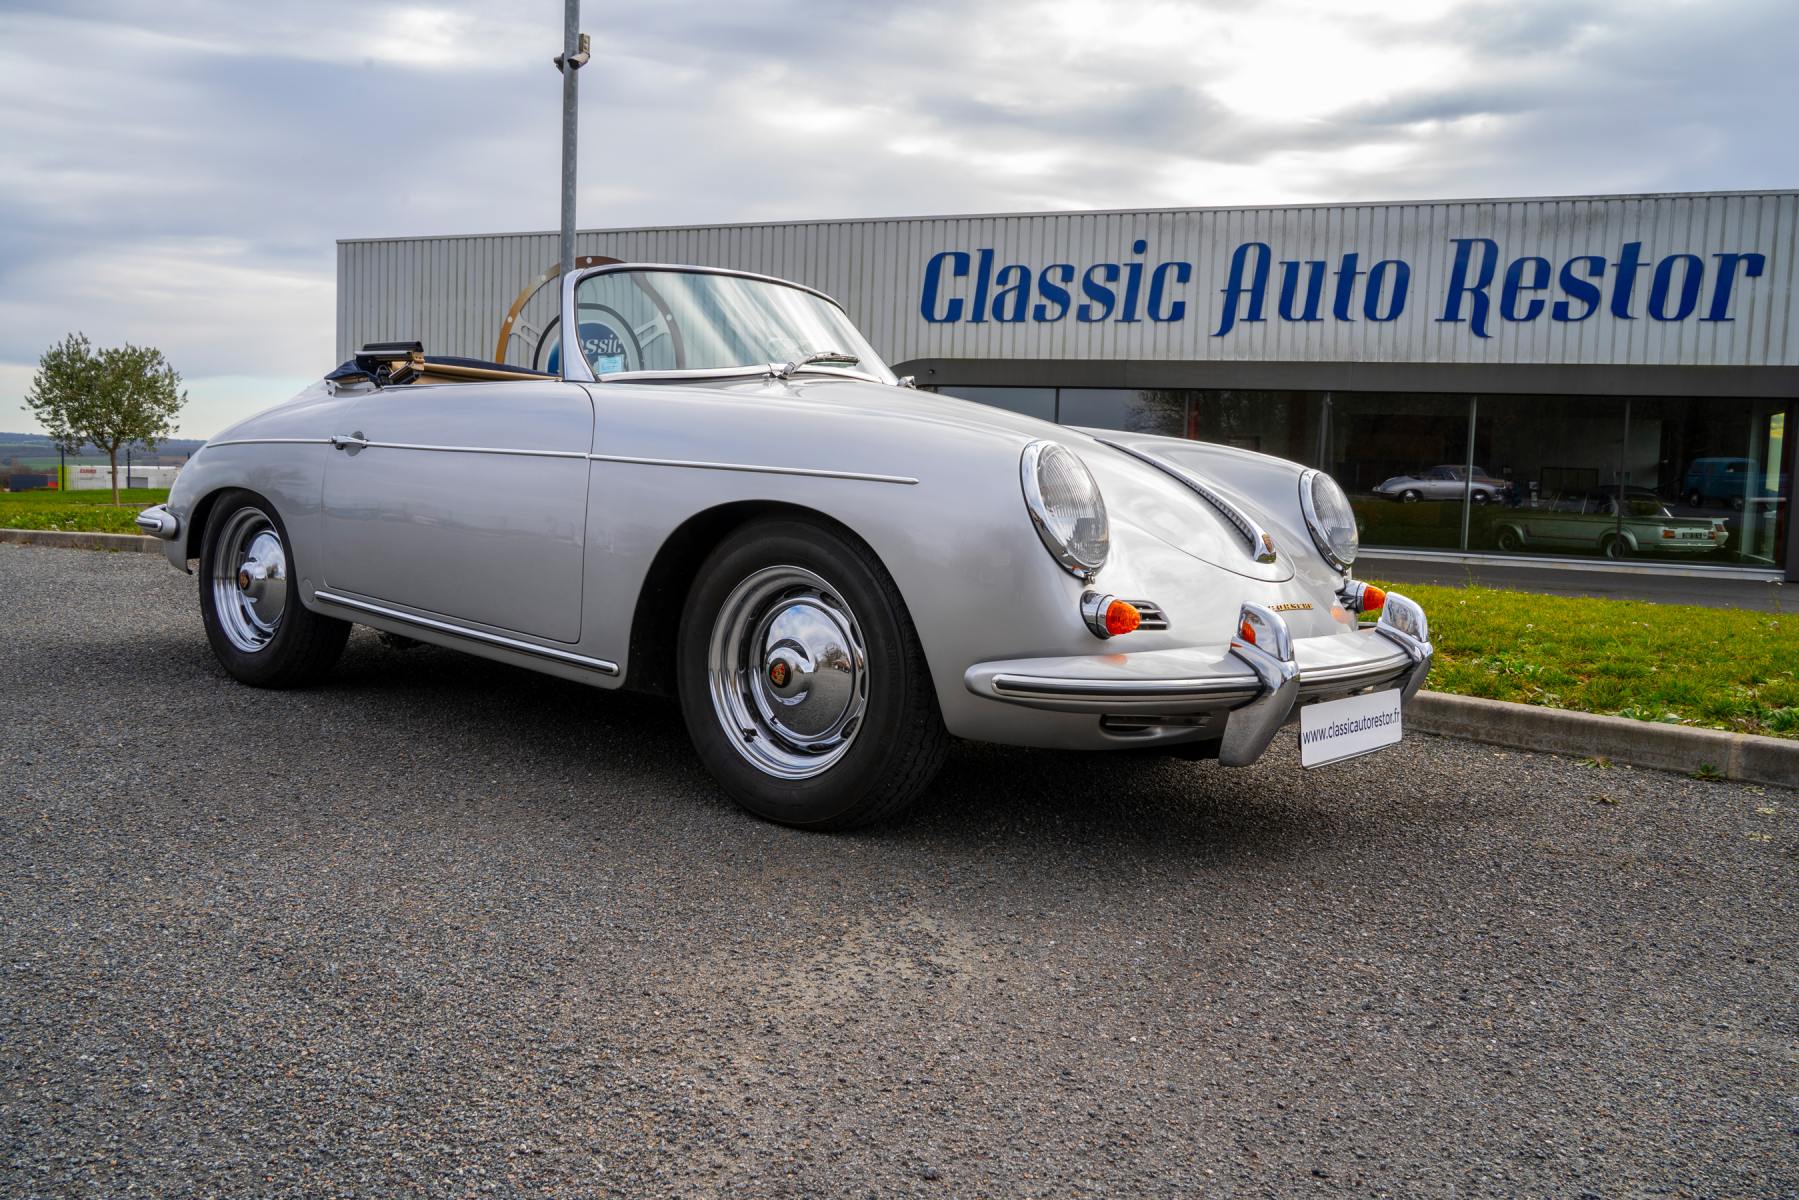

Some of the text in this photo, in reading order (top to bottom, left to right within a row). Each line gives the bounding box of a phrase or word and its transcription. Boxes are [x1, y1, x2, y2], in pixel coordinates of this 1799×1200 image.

[920, 238, 1766, 338] Classic Auto Restor
[581, 333, 622, 355] ssic
[1302, 707, 1400, 744] www.classicautorestor.fr
